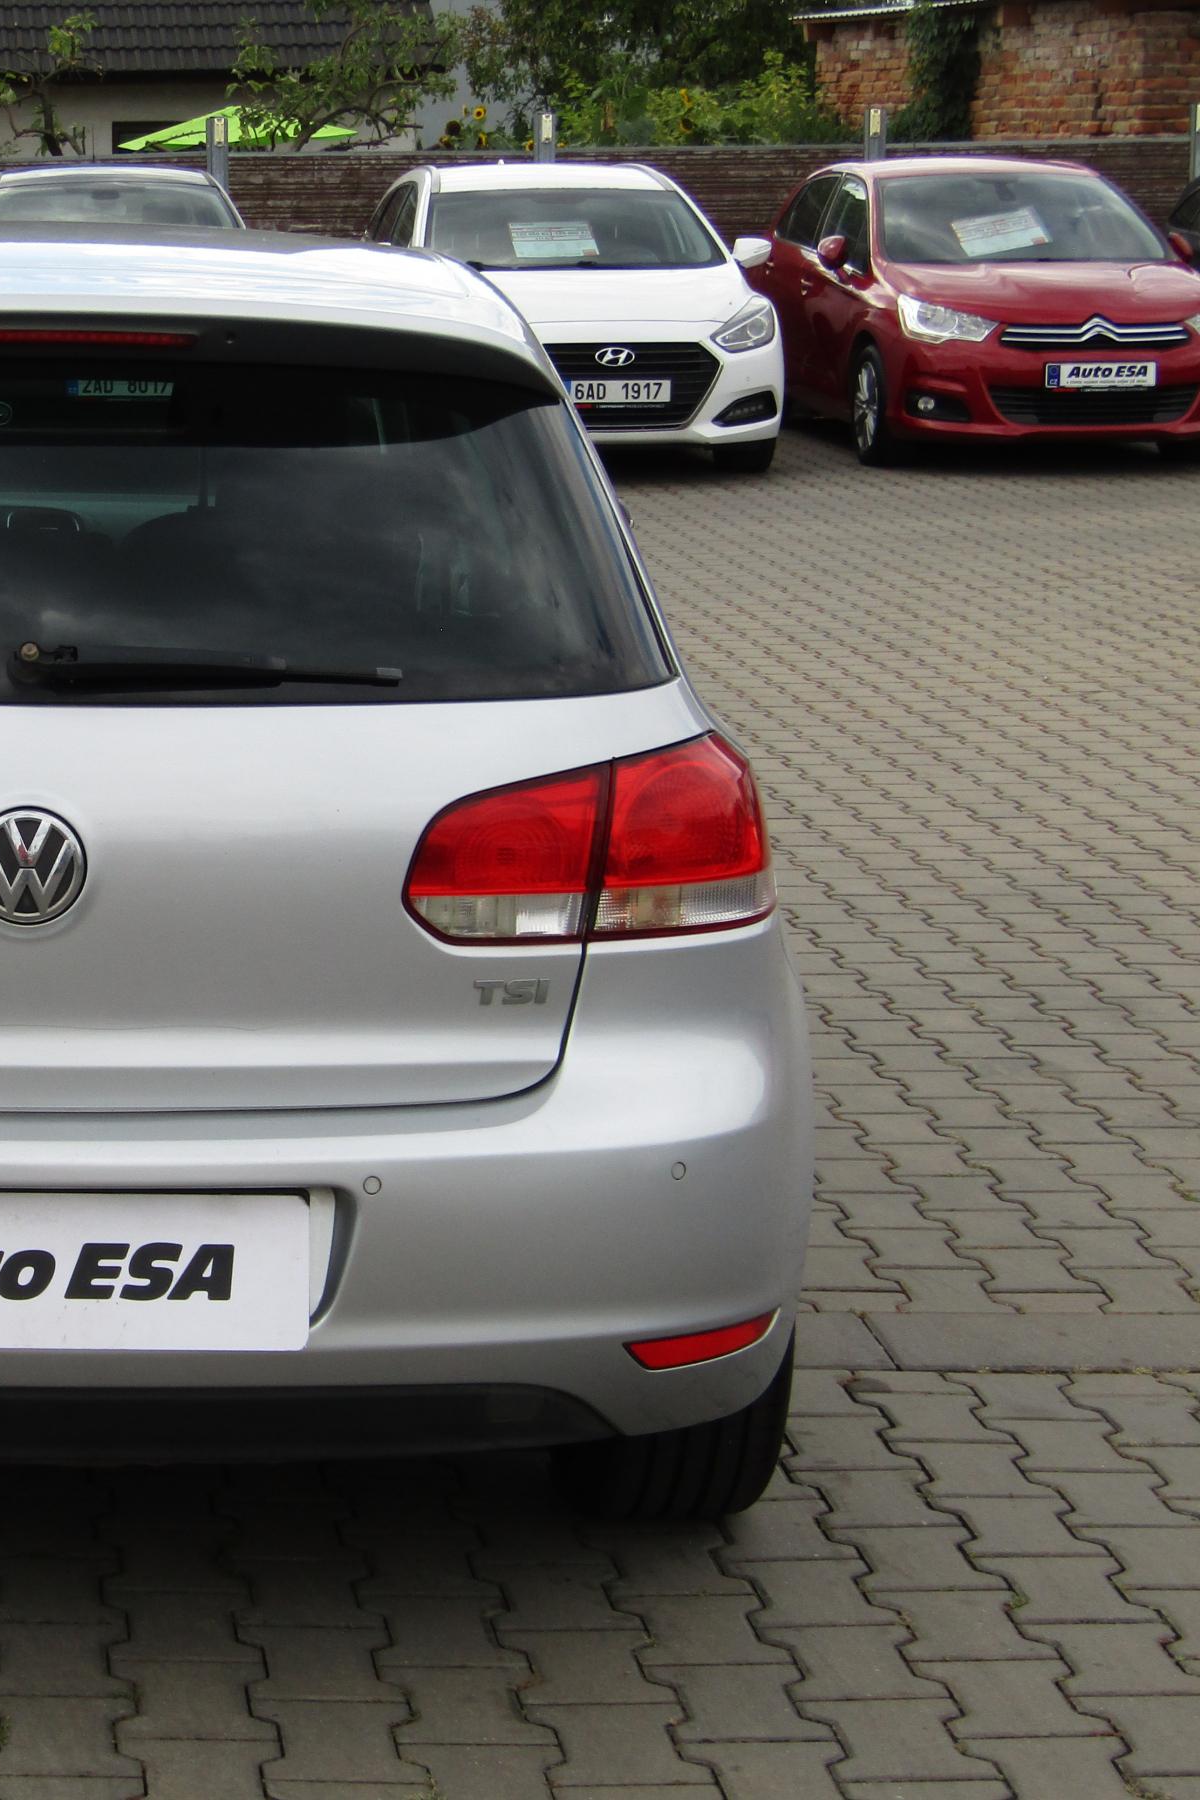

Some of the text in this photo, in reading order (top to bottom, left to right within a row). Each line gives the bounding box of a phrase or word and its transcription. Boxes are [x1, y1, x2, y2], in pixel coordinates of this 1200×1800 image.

[1067, 365, 1148, 378] Auto ESA
[575, 382, 662, 400] 6AD 1917
[473, 978, 550, 1005] TSI
[63, 1242, 235, 1301] ESA
